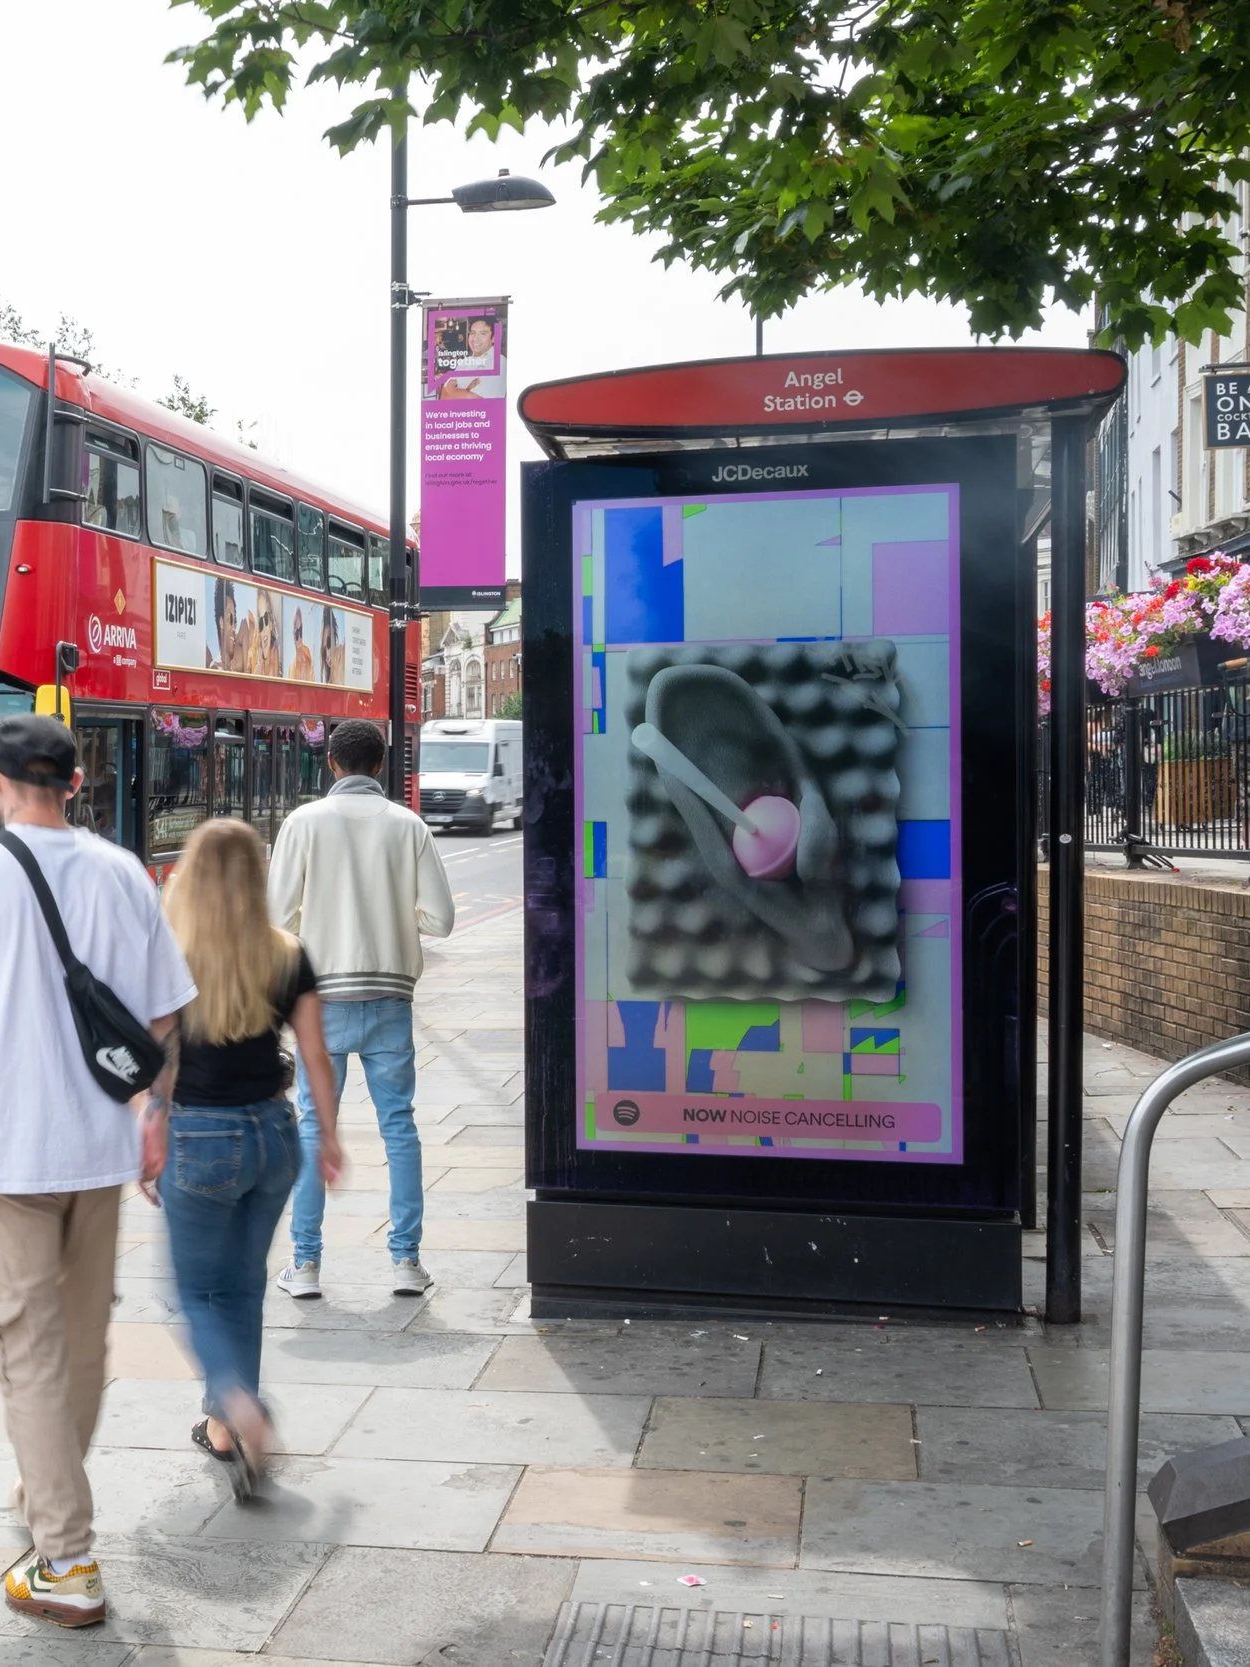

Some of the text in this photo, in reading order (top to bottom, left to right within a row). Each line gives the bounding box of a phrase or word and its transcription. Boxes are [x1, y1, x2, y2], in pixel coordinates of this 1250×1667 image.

[438, 350, 468, 358] Islington
[438, 357, 486, 369] together
[784, 368, 843, 390] Angel
[1216, 382, 1238, 395] BE
[764, 393, 836, 412] Station
[449, 410, 486, 419] investing
[434, 421, 454, 429] local
[455, 421, 472, 431] jobs
[473, 420, 490, 428] and
[425, 432, 469, 440] businesses
[461, 442, 492, 451] thriving
[445, 454, 484, 462] economy
[712, 464, 809, 483] JCDecaux
[165, 593, 197, 626] IZIPIZI
[103, 624, 137, 650] ARRIVA
[683, 1107, 895, 1130] NOW NOISE CANCELLING
